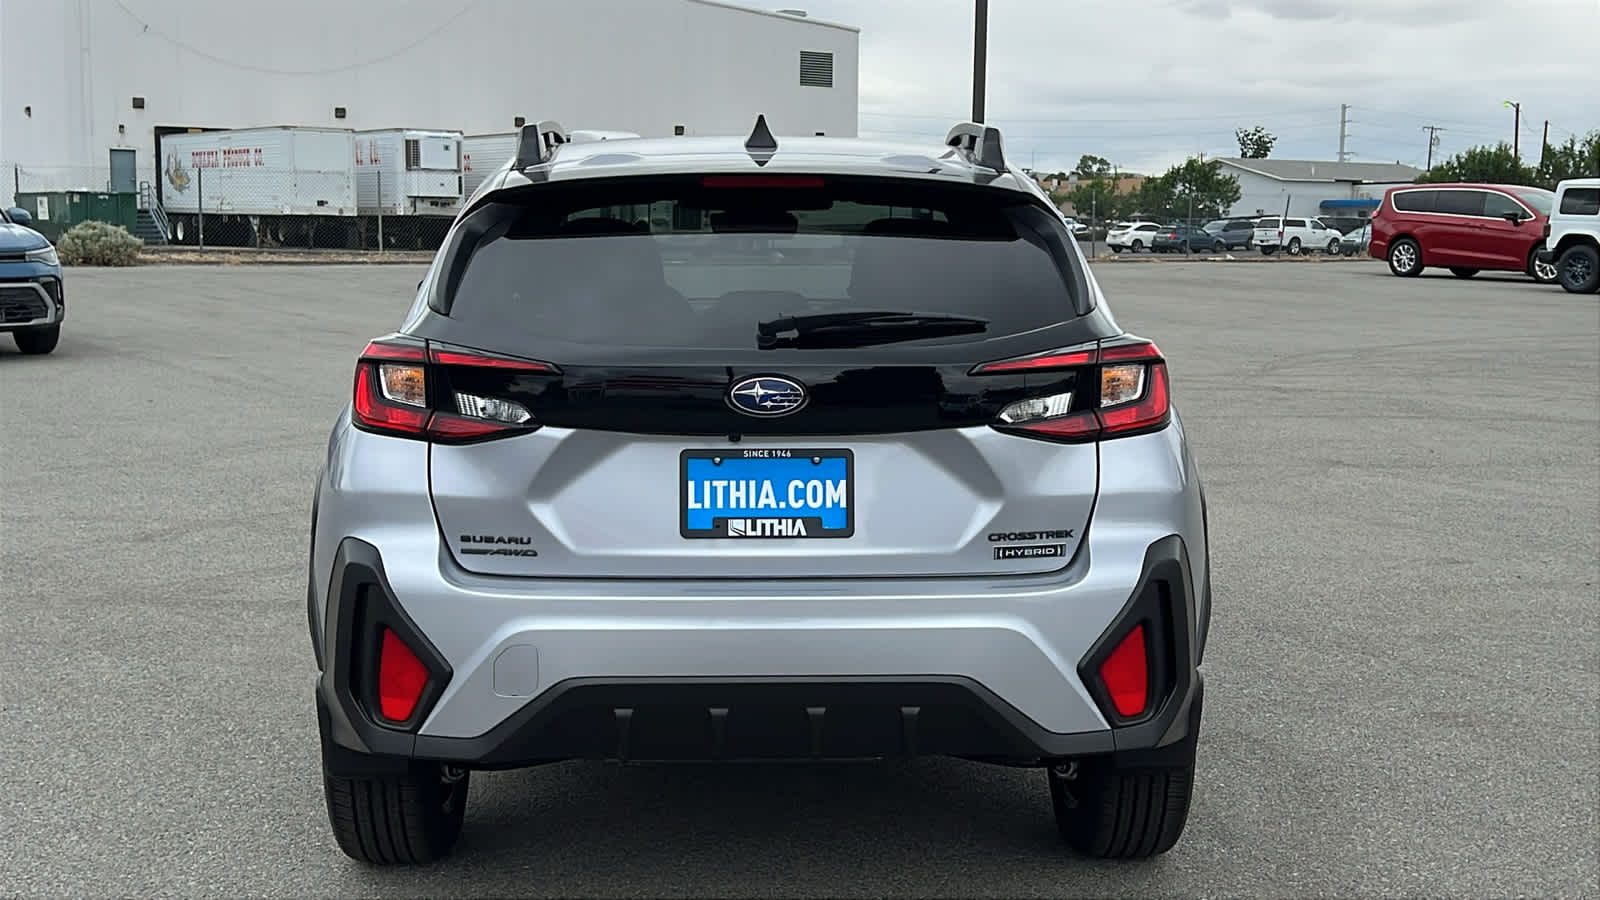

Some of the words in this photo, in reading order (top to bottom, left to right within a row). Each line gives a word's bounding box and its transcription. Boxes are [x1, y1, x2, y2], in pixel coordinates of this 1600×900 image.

[743, 450, 769, 458] SINCE
[772, 450, 792, 458] 1946
[687, 479, 847, 509] LITHIA.COM
[745, 518, 807, 536] LITHIA
[460, 535, 532, 545] SUBARU
[988, 529, 1074, 542] CROSSTREK
[1005, 547, 1055, 557] HYBRID
